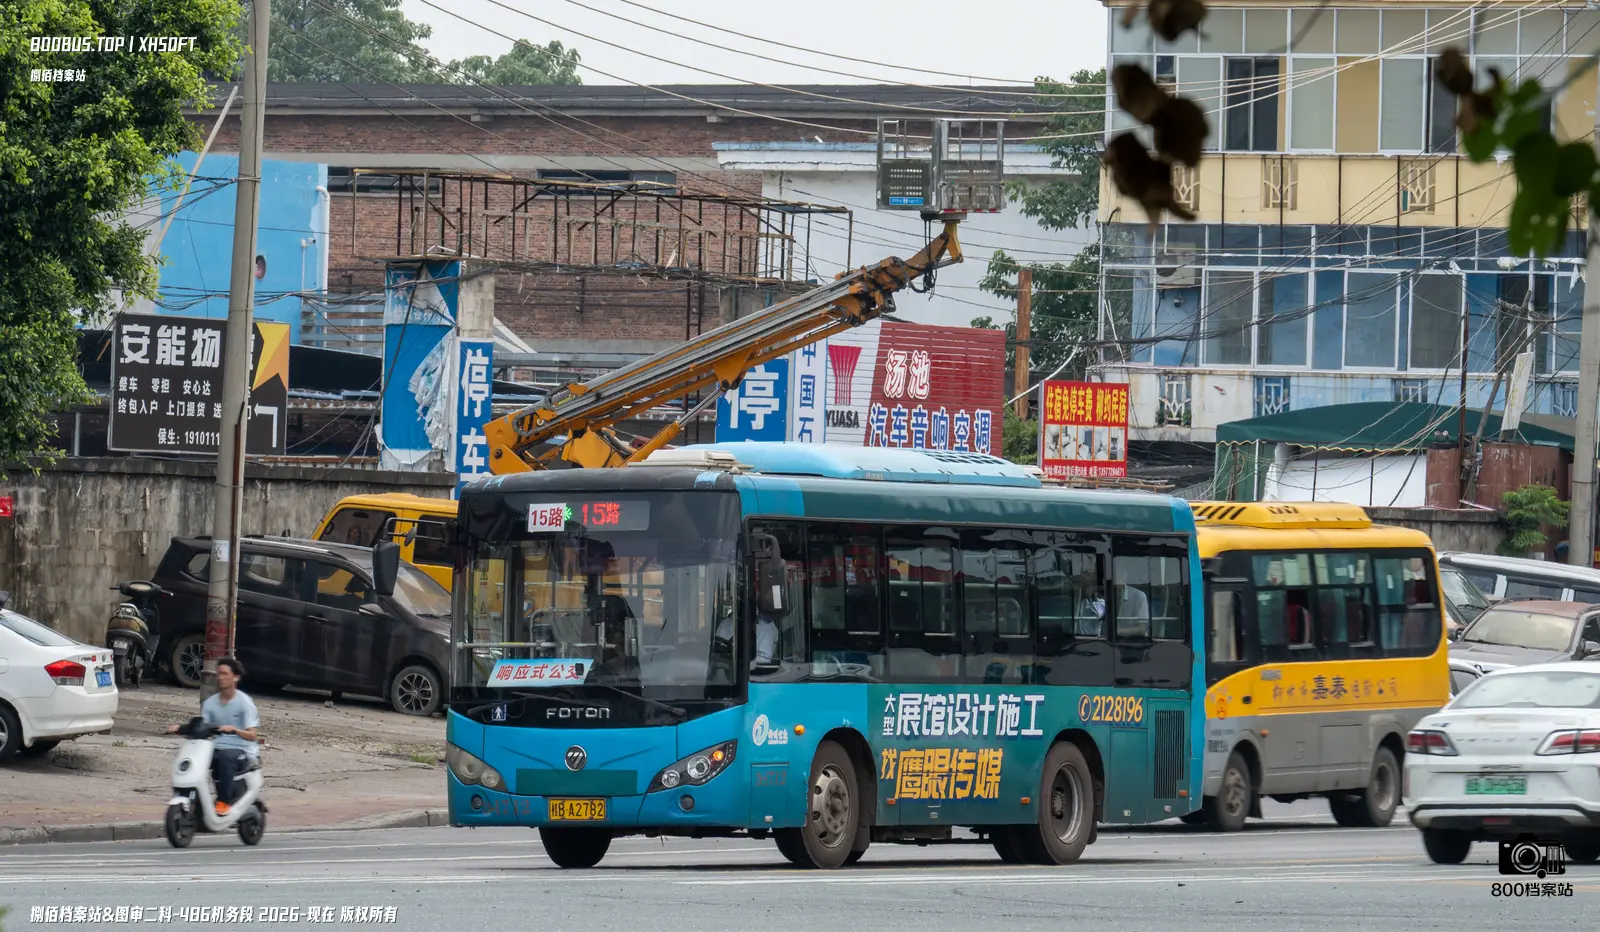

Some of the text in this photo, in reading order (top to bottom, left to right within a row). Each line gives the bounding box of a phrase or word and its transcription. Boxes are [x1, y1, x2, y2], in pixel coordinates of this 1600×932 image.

[120, 324, 255, 370] 安能物
[183, 379, 211, 396] 安心达
[166, 400, 206, 418] 上门提货
[826, 409, 860, 429] YUASA
[869, 402, 992, 455] 汽车音响空调
[531, 507, 563, 527] 15路
[582, 502, 620, 525] 15路
[496, 664, 580, 680] 响应式公交
[546, 707, 610, 719] FOTON
[896, 693, 1045, 736] 展馆设计施工
[1092, 695, 1143, 722] 2128196
